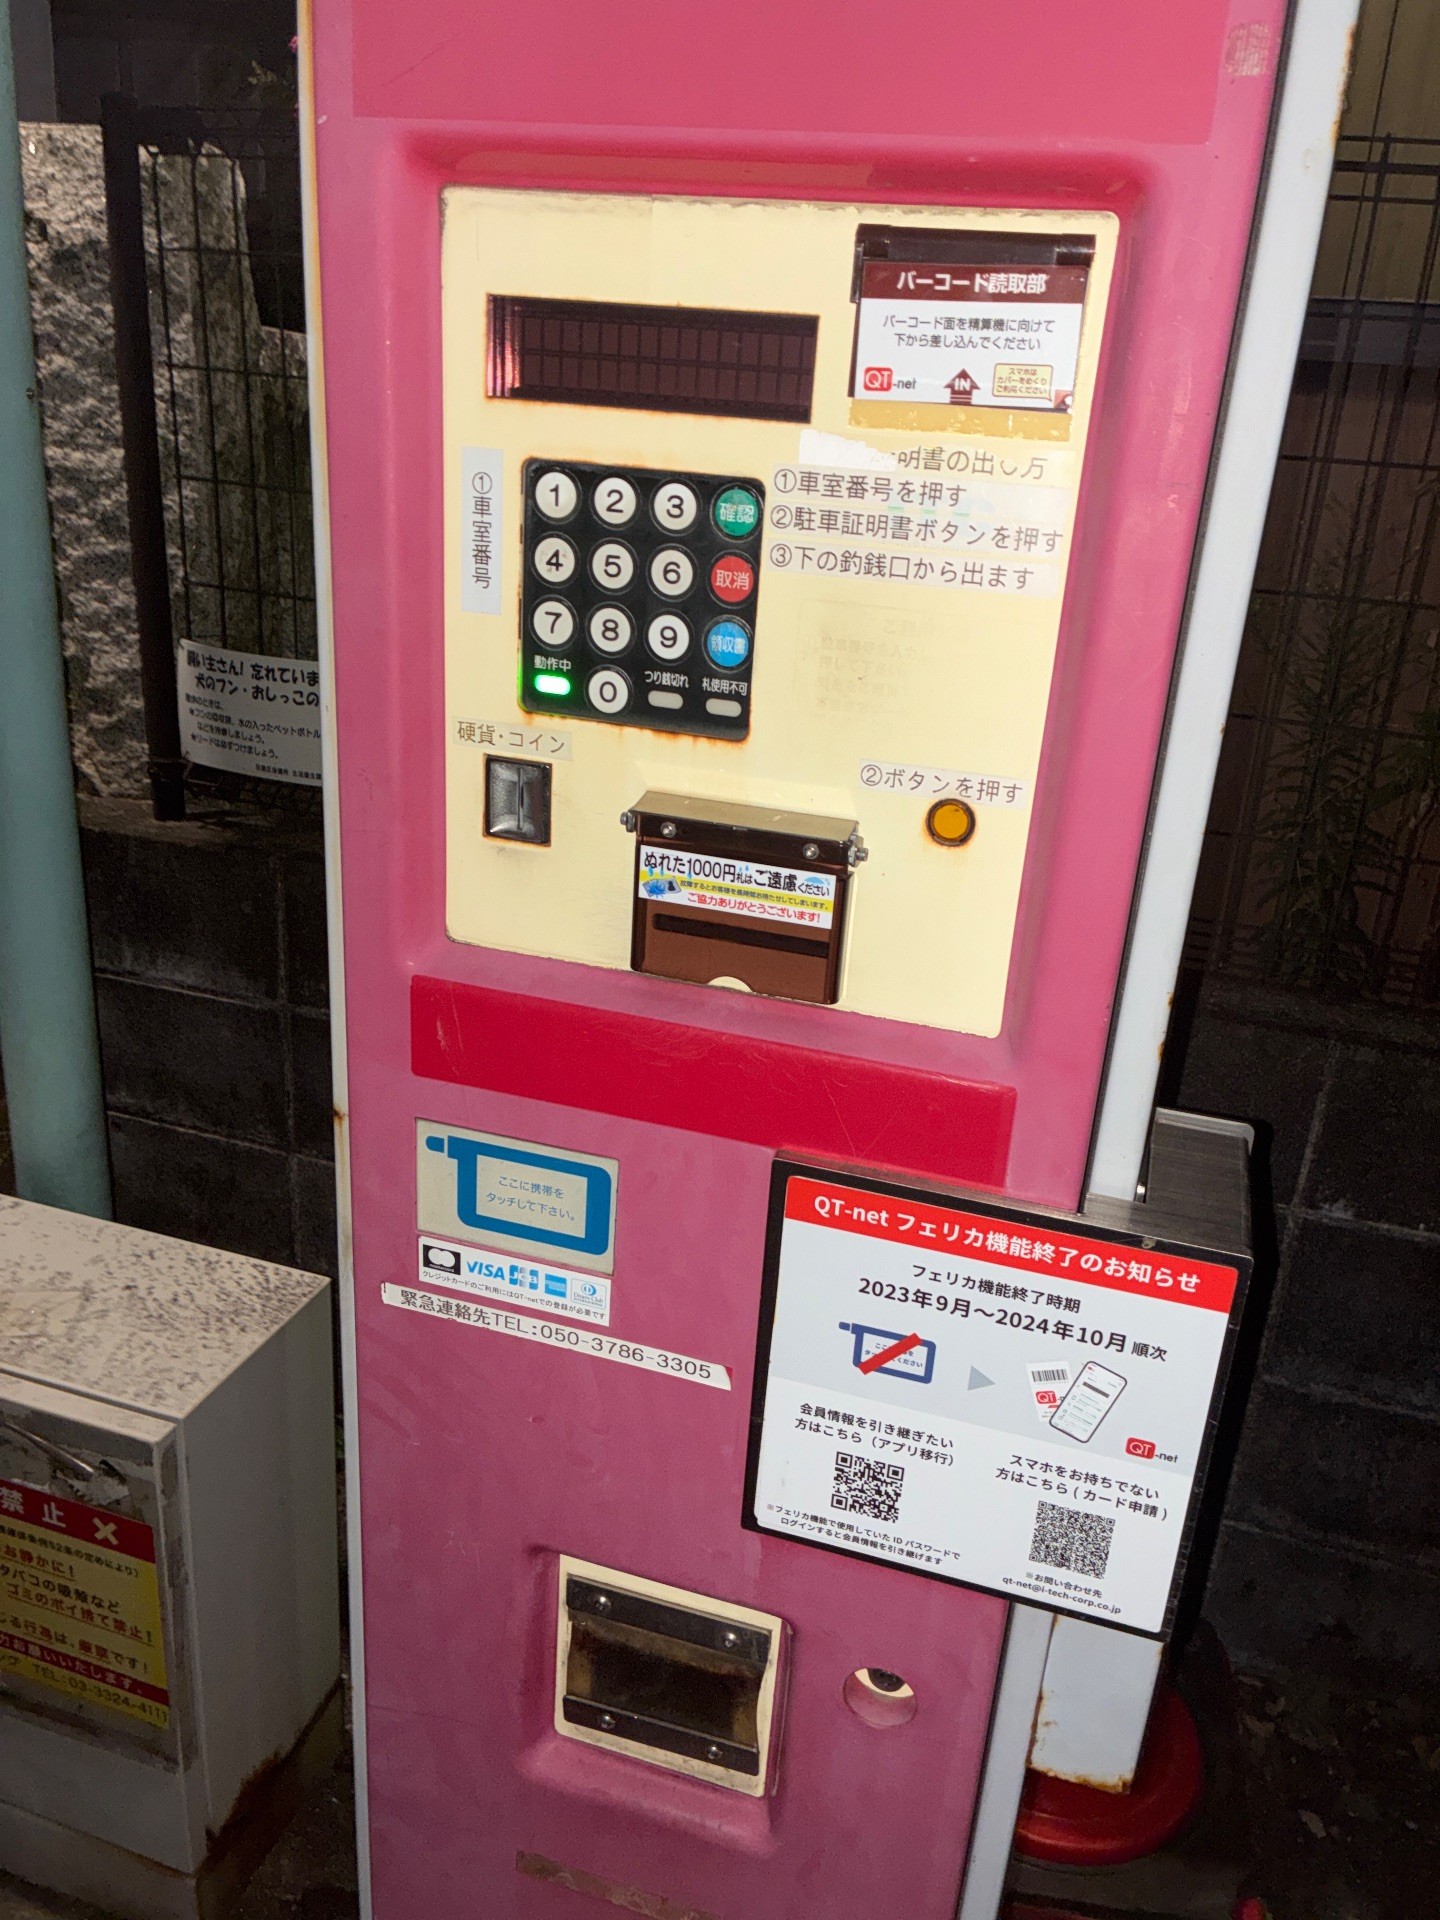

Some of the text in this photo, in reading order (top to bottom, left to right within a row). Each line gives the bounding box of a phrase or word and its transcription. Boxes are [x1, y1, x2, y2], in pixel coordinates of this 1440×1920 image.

[897, 271, 1047, 295] バーコード読取部
[883, 314, 1056, 333] バーコード面を精算機に向けて
[894, 332, 1041, 352] 下から差し込んでください
[864, 369, 917, 390] QT-net
[953, 377, 971, 391] IN
[549, 484, 560, 507] 1
[774, 468, 967, 507] ①車室番号を押す
[606, 490, 623, 513] 2
[666, 495, 684, 518] 3
[471, 471, 493, 589] ①車室番号
[770, 505, 1064, 552] ②駐車証明書ボタンを押す
[546, 549, 563, 571] 4
[603, 554, 621, 577] 5
[770, 543, 1035, 589] ③下の釣銭口から出ます
[662, 562, 681, 584] 6
[715, 570, 750, 590] 取消
[545, 611, 562, 634] 7
[601, 618, 619, 641] 8
[660, 626, 677, 648] 9
[534, 655, 572, 672] 動作中
[644, 671, 689, 688] つり銭切れ
[702, 677, 748, 696] 札使用不可
[599, 681, 617, 703] 0
[457, 721, 565, 753] 硬貨・コイン
[860, 763, 1023, 803] ②ボタンを押す
[644, 851, 830, 897] ぬれた1000円札はご遠慮ください
[687, 892, 821, 923] ご協力ありがとうございます!
[498, 1175, 565, 1199] ここに携帯を
[486, 1191, 575, 1221] タッチして下さい。
[814, 1196, 1201, 1294] QT-net フェリカ機能終了のお知らせ
[466, 1261, 506, 1281] VISA
[509, 1266, 539, 1288] JCB
[912, 1264, 1081, 1315] フェリカ機能終了時期
[400, 1288, 712, 1379] 緊急連絡先TEL:050-3786-3305
[1131, 1341, 1167, 1362] 順次
[800, 1402, 954, 1449] 会員情報を引き継ぎたい
[1128, 1440, 1178, 1463] QT-net
[1010, 1454, 1160, 1500] スマホをお持ちでない
[781, 1517, 943, 1564] ログインすると会員情報を引き継げます
[893, 1536, 903, 1545] ID
[905, 1539, 961, 1560] パスワードで
[1002, 1577, 1121, 1614] qt-net@i-tech-corp.co.jp
[1025, 1571, 1103, 1598] ※お問い合わせ先
